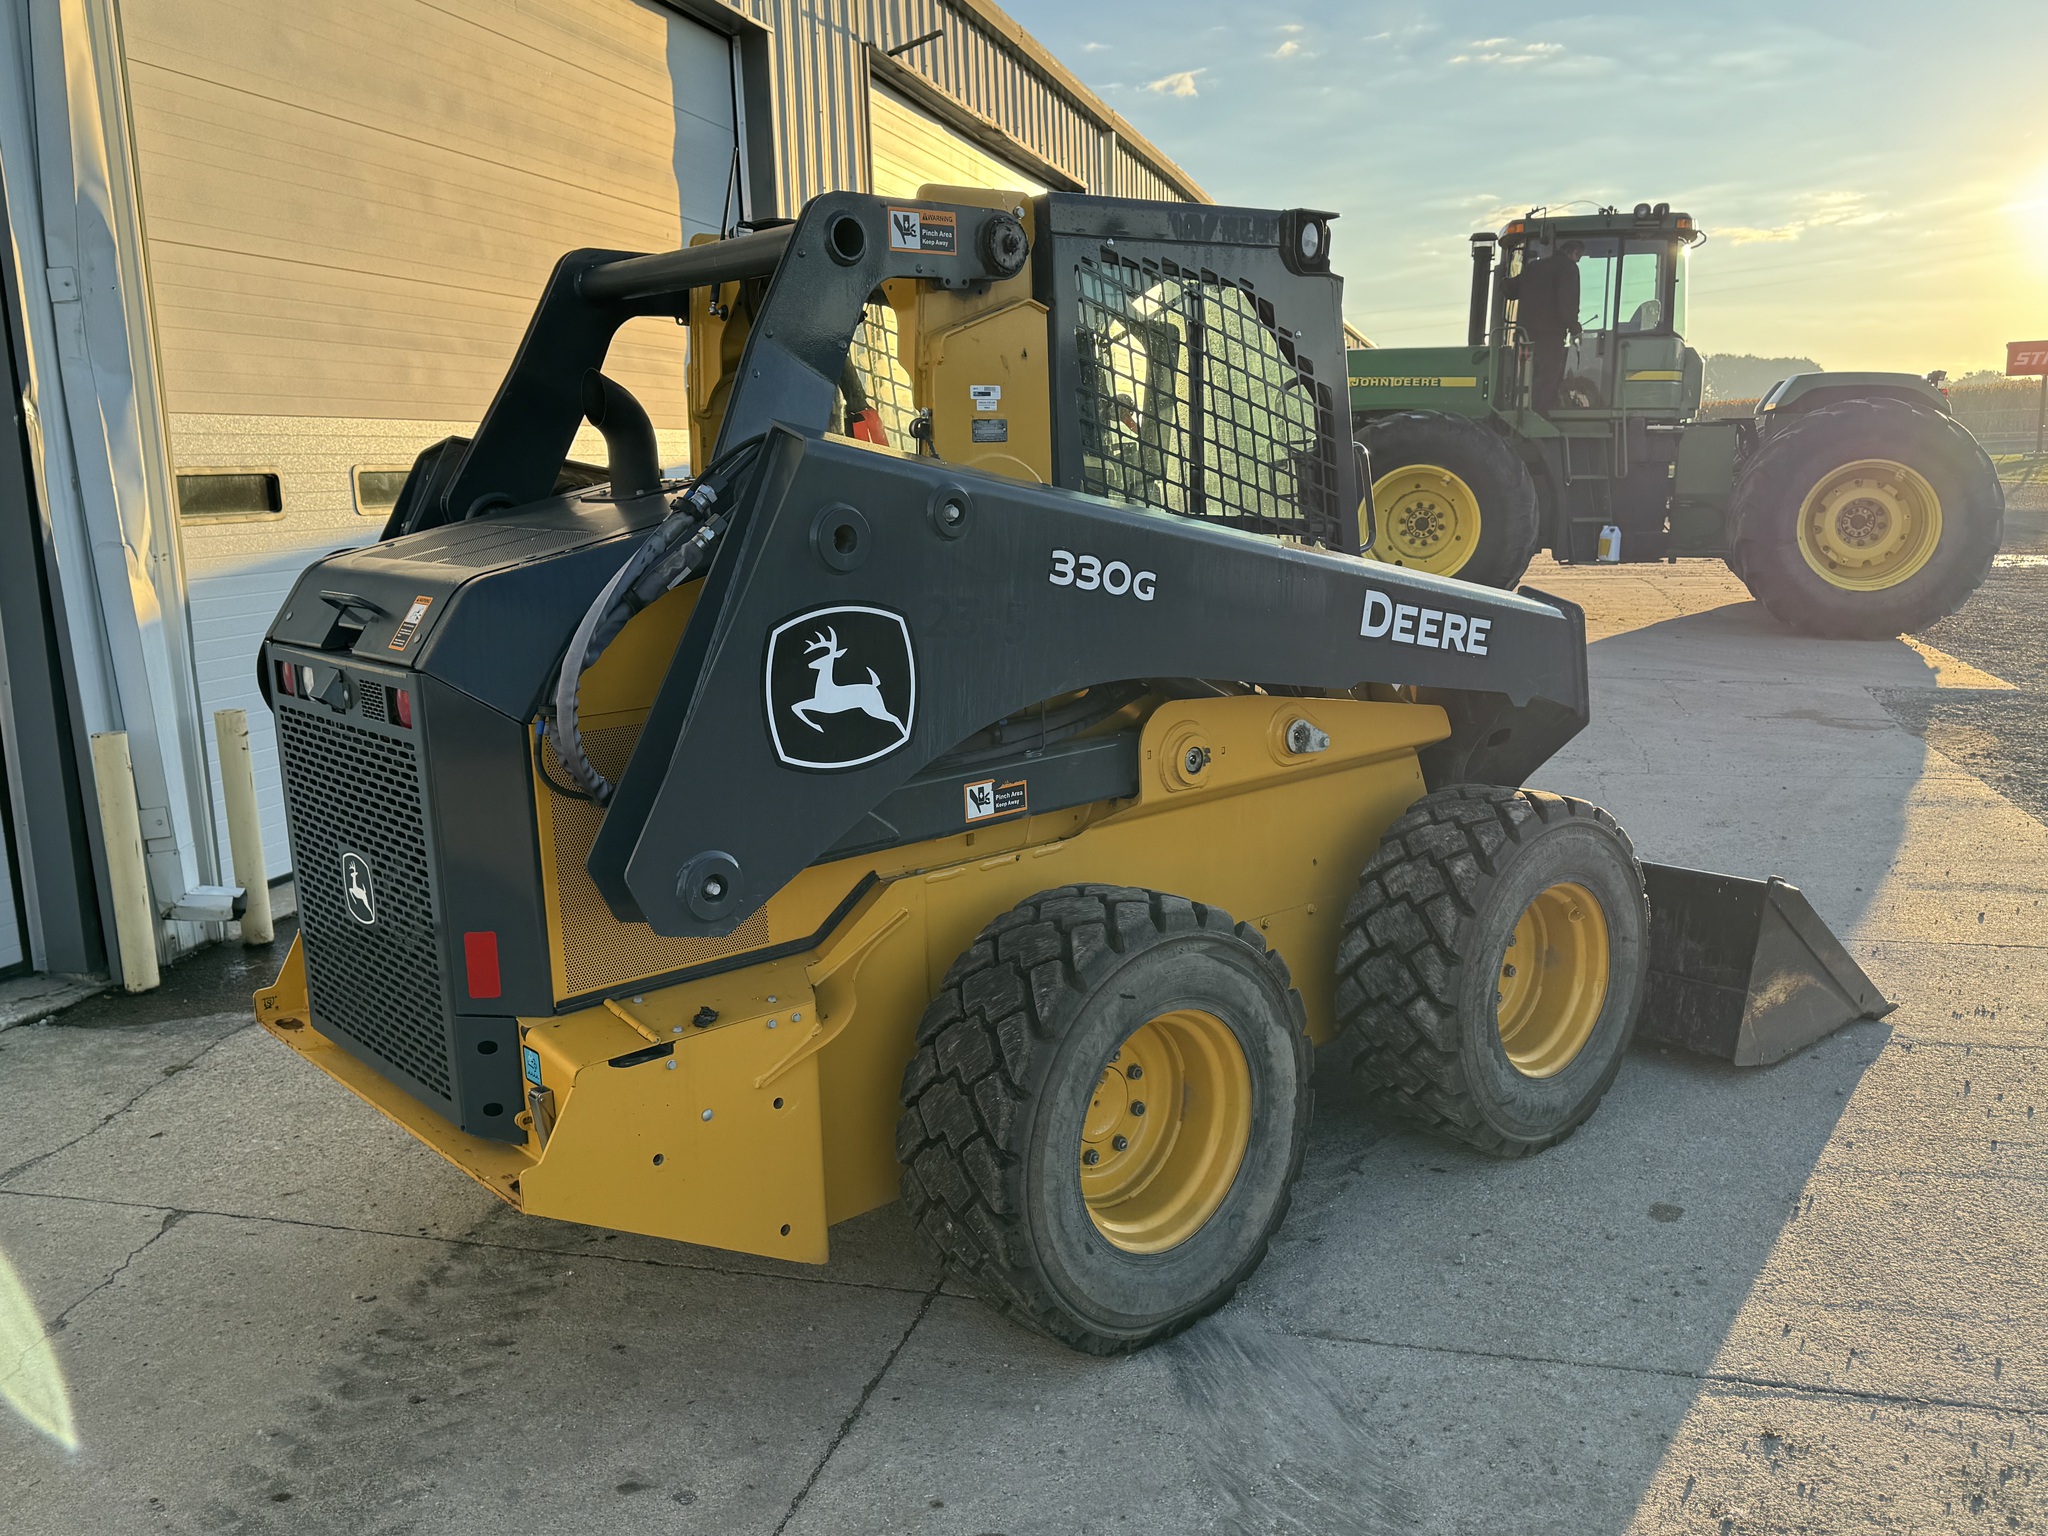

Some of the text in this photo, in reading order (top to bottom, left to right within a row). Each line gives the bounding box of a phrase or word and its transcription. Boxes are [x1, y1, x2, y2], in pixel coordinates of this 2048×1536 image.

[922, 228, 953, 238] Pinch Area
[922, 238, 949, 247] Keep Away
[1351, 377, 1439, 387] JOHN DEERE
[1049, 549, 1157, 601] 330G
[1360, 589, 1492, 656] DEERE
[995, 793, 1010, 801] Pinch
[995, 801, 1008, 809] Keep
